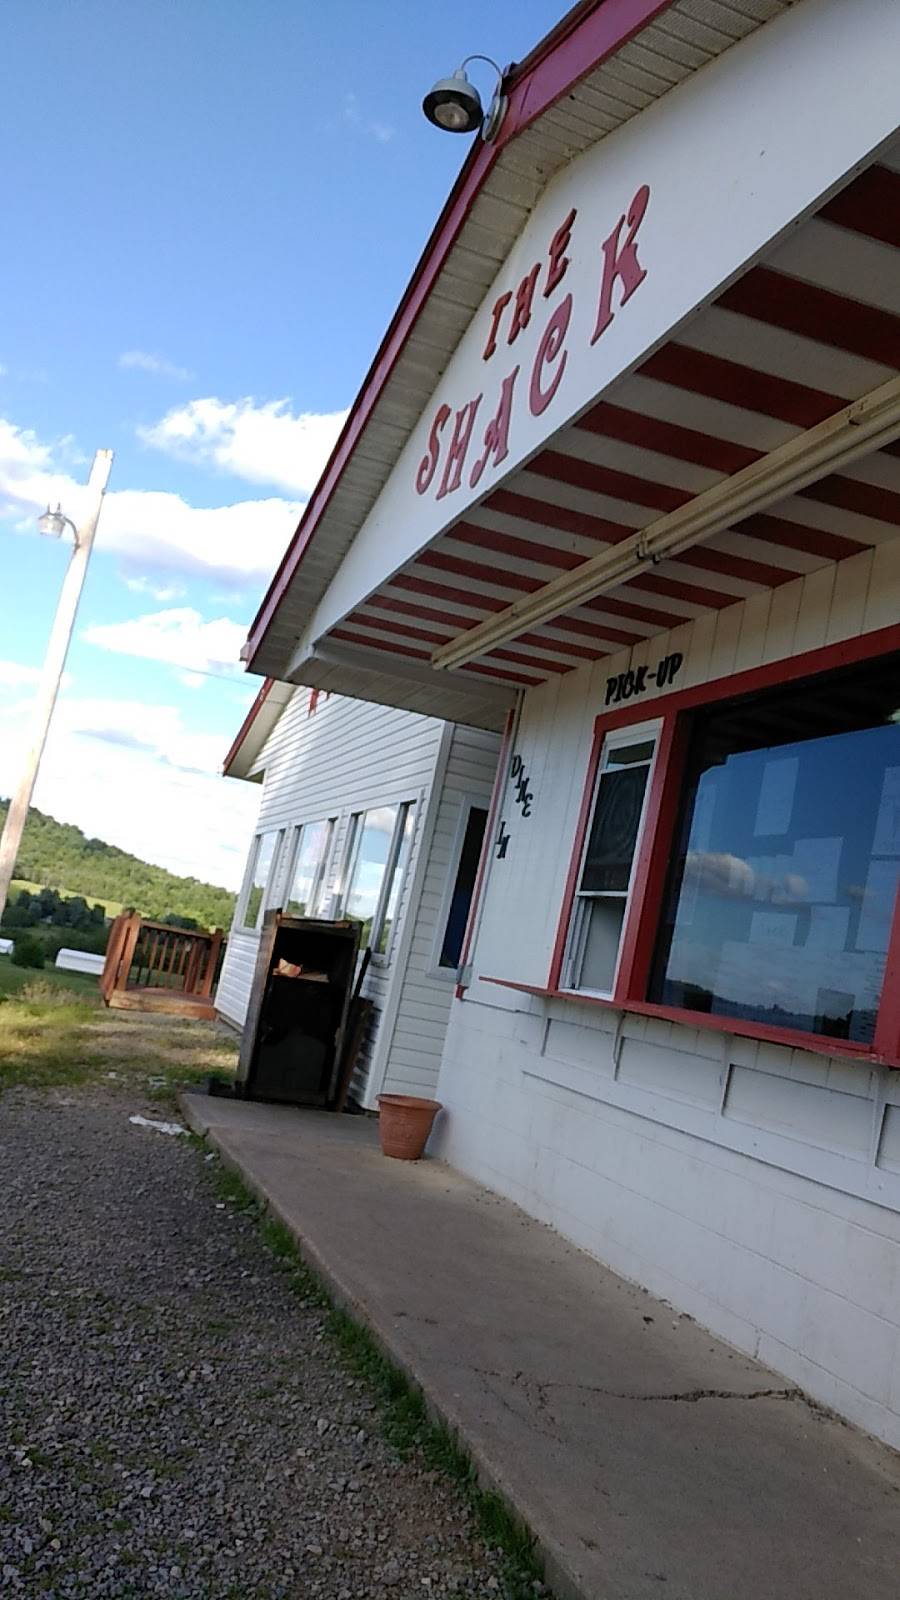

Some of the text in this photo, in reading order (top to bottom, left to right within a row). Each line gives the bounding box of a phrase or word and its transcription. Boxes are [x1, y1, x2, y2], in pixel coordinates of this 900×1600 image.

[416, 184, 650, 500] SHACK
[482, 208, 577, 362] THE
[605, 652, 683, 705] PICK-UP
[496, 755, 533, 859] DINE IN
